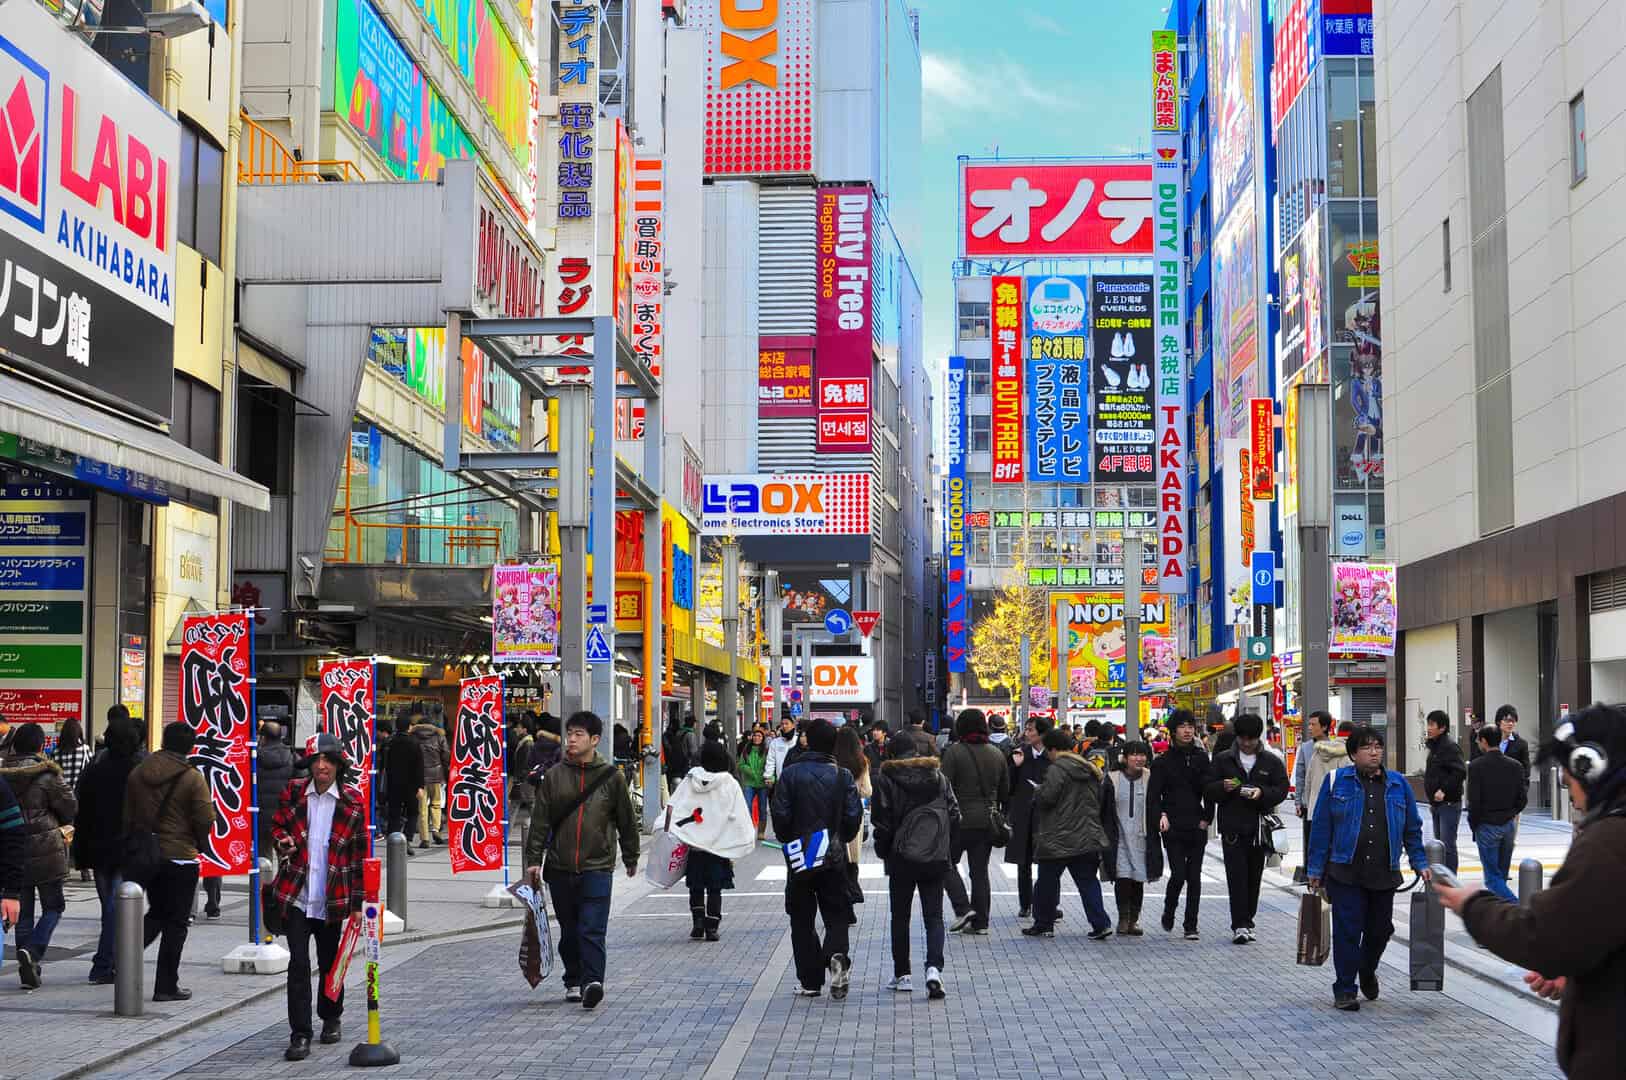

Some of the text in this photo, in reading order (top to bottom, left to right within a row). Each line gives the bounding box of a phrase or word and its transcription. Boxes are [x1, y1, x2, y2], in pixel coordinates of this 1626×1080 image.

[1326, 19, 1354, 34] 秋葉原
[559, 0, 595, 218] ディオ 電化製品
[1156, 51, 1175, 127] まんが喫茶
[60, 83, 169, 252] LABI
[57, 208, 170, 307] AKIHABARA
[636, 217, 660, 272] 買取り
[820, 194, 836, 298] Flagship Store
[835, 193, 868, 330] Duty Free
[996, 283, 1018, 328] 免税
[1096, 282, 1151, 293] Panasonic
[824, 383, 865, 403] 免税
[996, 381, 1018, 421] DUTY
[1159, 183, 1183, 577] DUTY FREE 免税店 TAKARADA
[823, 420, 866, 437] 면세점
[950, 368, 965, 465] Panasonic
[997, 422, 1018, 459] FREE
[1036, 364, 1057, 476] プラズマテレビ
[1061, 364, 1081, 477] 液晶テレビ
[995, 463, 1020, 479] B1F
[1099, 454, 1152, 472] 4F照明
[704, 517, 824, 528] ome Electronics Store
[950, 477, 964, 556] ONODEN
[1068, 603, 1165, 624] NODN
